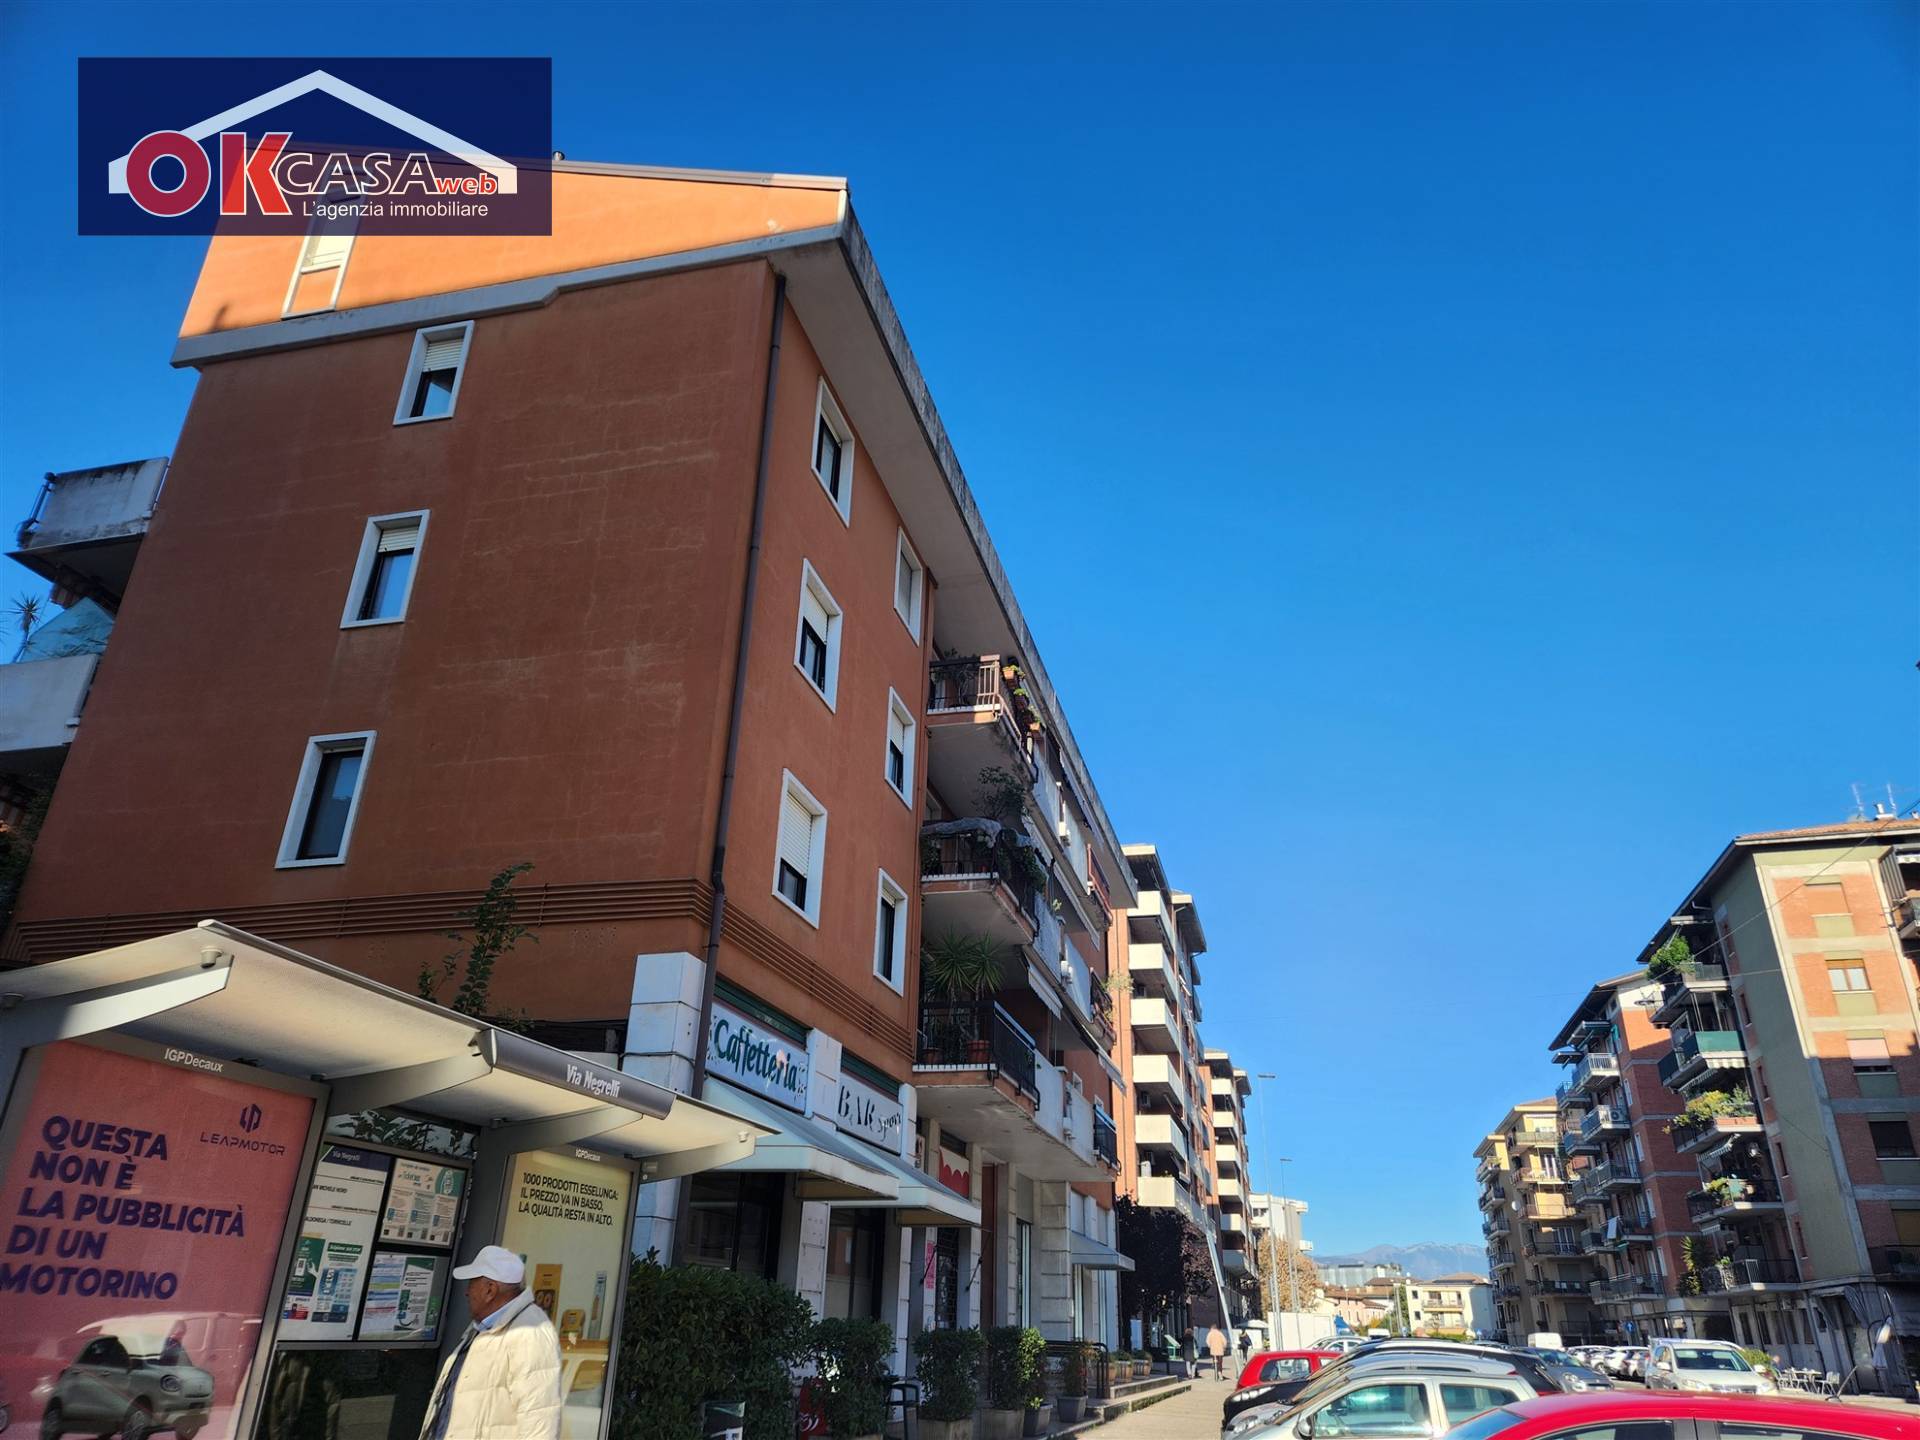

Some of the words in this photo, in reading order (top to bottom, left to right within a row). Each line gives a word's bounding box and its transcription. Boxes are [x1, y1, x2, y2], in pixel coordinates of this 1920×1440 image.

[164, 1047, 225, 1073] IGPDecaux
[713, 1019, 798, 1092] Caffetteria
[566, 1064, 582, 1085] Via
[583, 1070, 621, 1098] Negrelli
[42, 1115, 169, 1161] QUESTA
[200, 1131, 286, 1157] LEAPMOTOR
[30, 1150, 112, 1188] NON
[113, 1154, 138, 1191] È
[523, 1173, 541, 1186] 1000
[542, 1176, 579, 1193] PRODOTTI
[17, 1187, 66, 1220] LA
[73, 1194, 246, 1238] PUBBLICITÀ
[518, 1201, 529, 1213] LA
[564, 1209, 585, 1222] RESTA
[587, 1212, 594, 1222] IN
[520, 1187, 528, 1199] IL
[529, 1189, 560, 1203] PREZZO
[561, 1193, 571, 1203] VA
[571, 1196, 579, 1207] IN
[6, 1225, 49, 1257] DI
[56, 1230, 109, 1260] UN
[0, 1262, 178, 1301] MOTORINO
